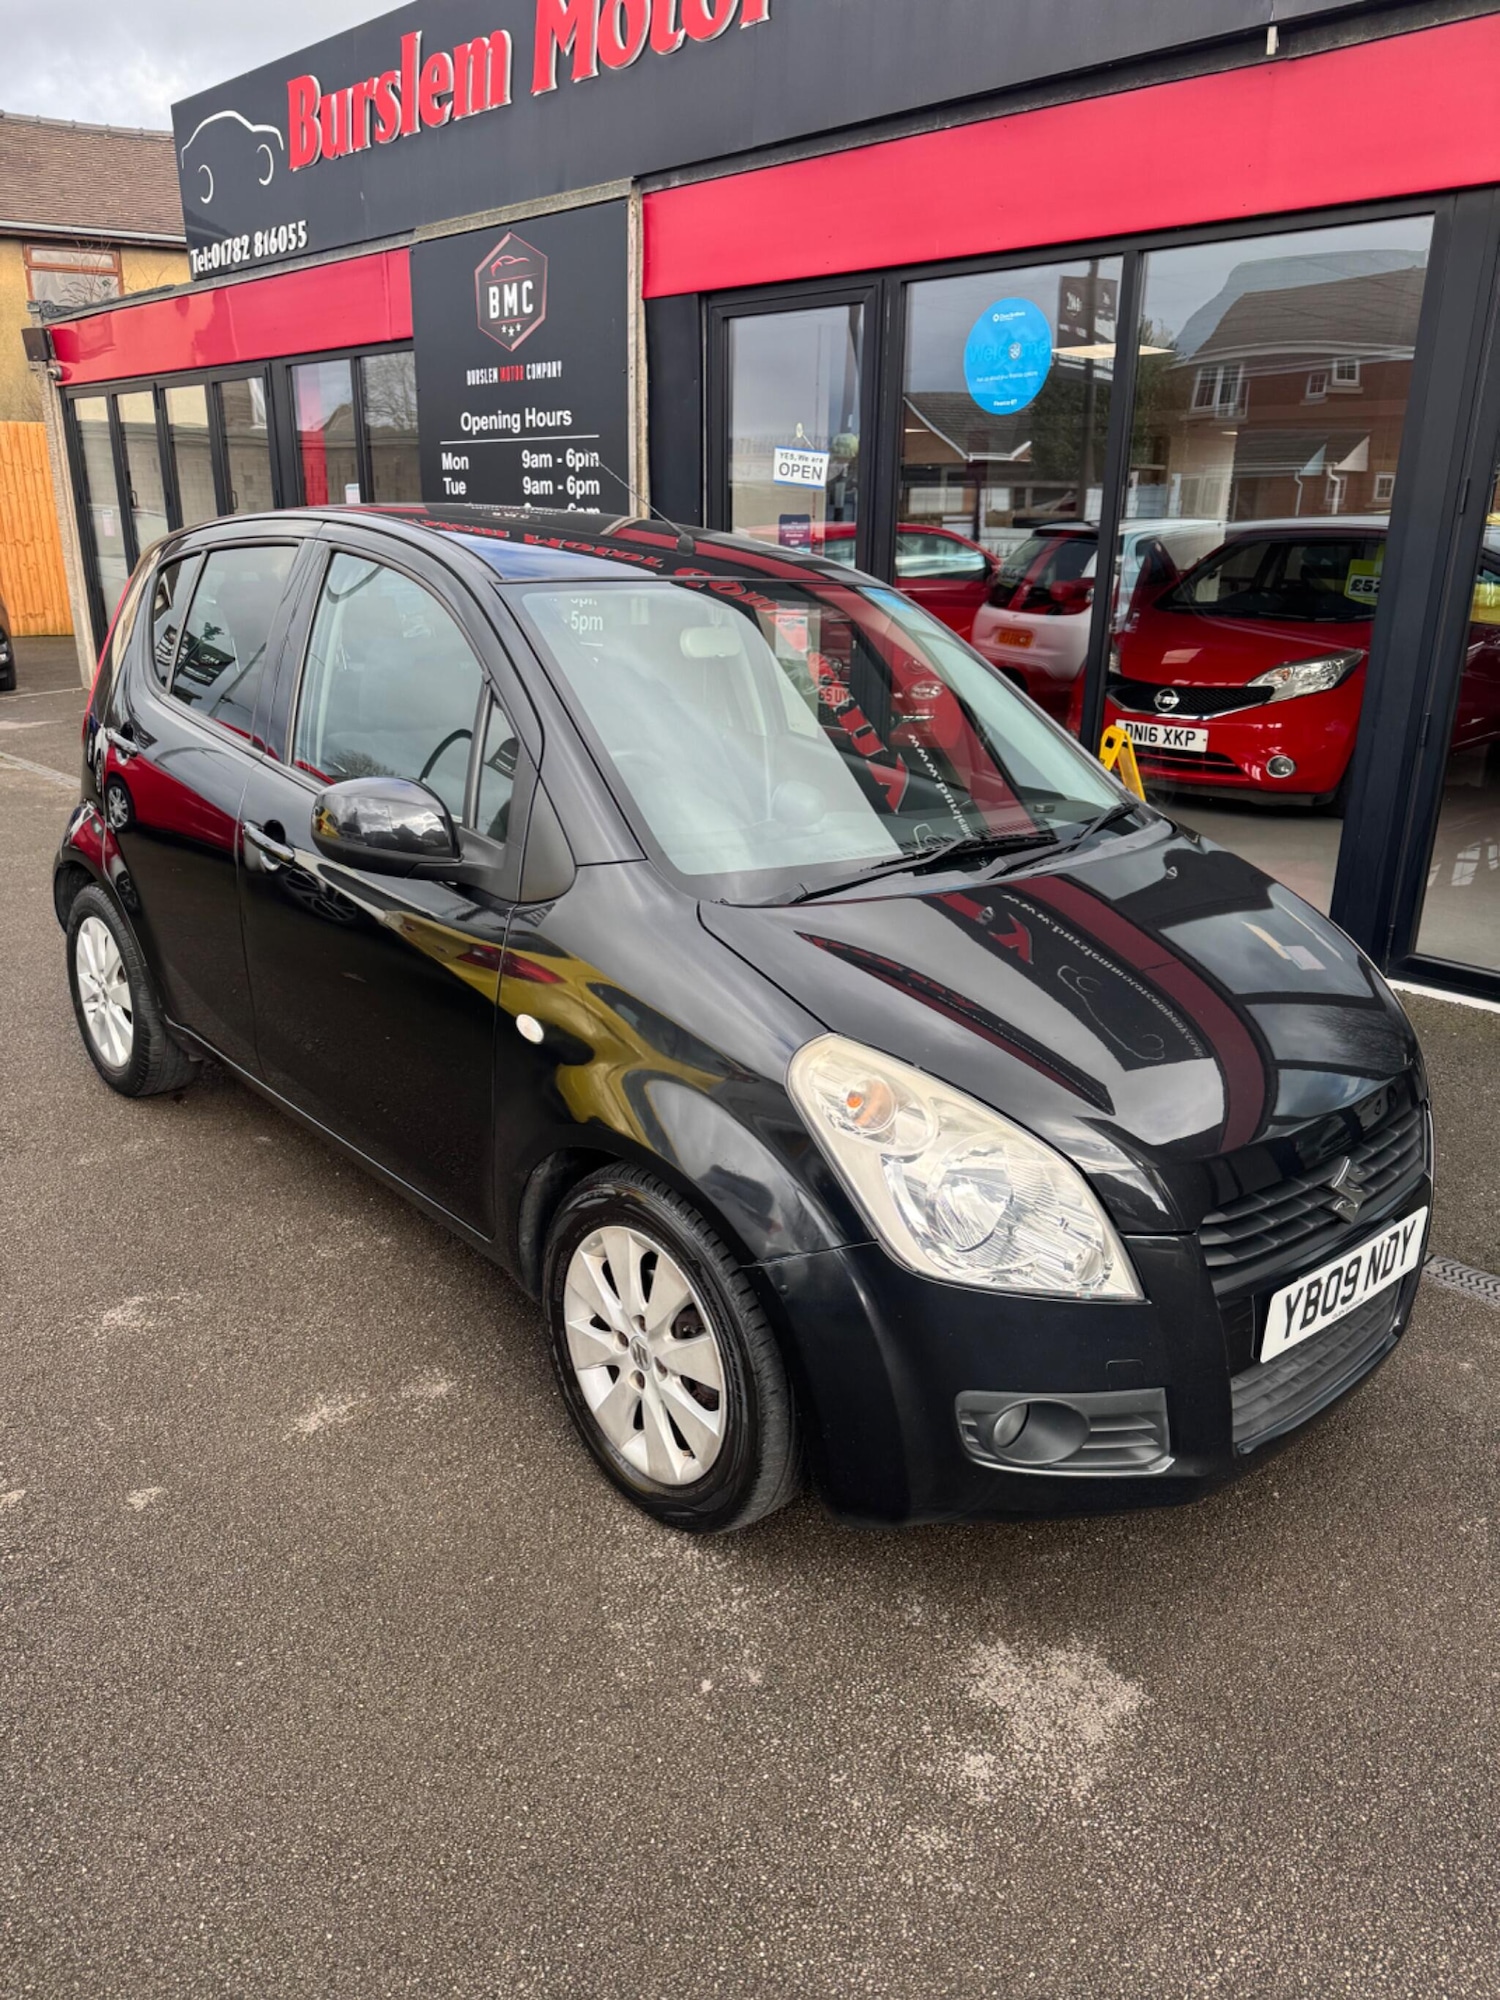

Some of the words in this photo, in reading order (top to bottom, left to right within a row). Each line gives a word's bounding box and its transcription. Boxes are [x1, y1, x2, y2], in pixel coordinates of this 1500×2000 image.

[287, 29, 512, 171] Burslem
[190, 234, 250, 274] Tel:01782
[254, 220, 308, 258] 816055
[488, 279, 534, 319] BMC
[500, 365, 524, 382] MOTOR
[526, 360, 562, 380] COMPANY
[460, 410, 521, 435] Opening
[525, 408, 572, 428] Hours
[441, 452, 469, 471] Mon
[522, 450, 553, 468] 9am
[565, 448, 600, 471] 6pm
[779, 462, 823, 481] OPEN
[443, 477, 467, 496] Tue
[523, 477, 553, 495] 9am
[567, 476, 600, 499] 6pm
[570, 610, 604, 635] 5pm
[1124, 723, 1158, 744] DN16
[1163, 727, 1196, 748] XKP
[1283, 1257, 1363, 1340] YB09
[1364, 1218, 1417, 1289] NDY
